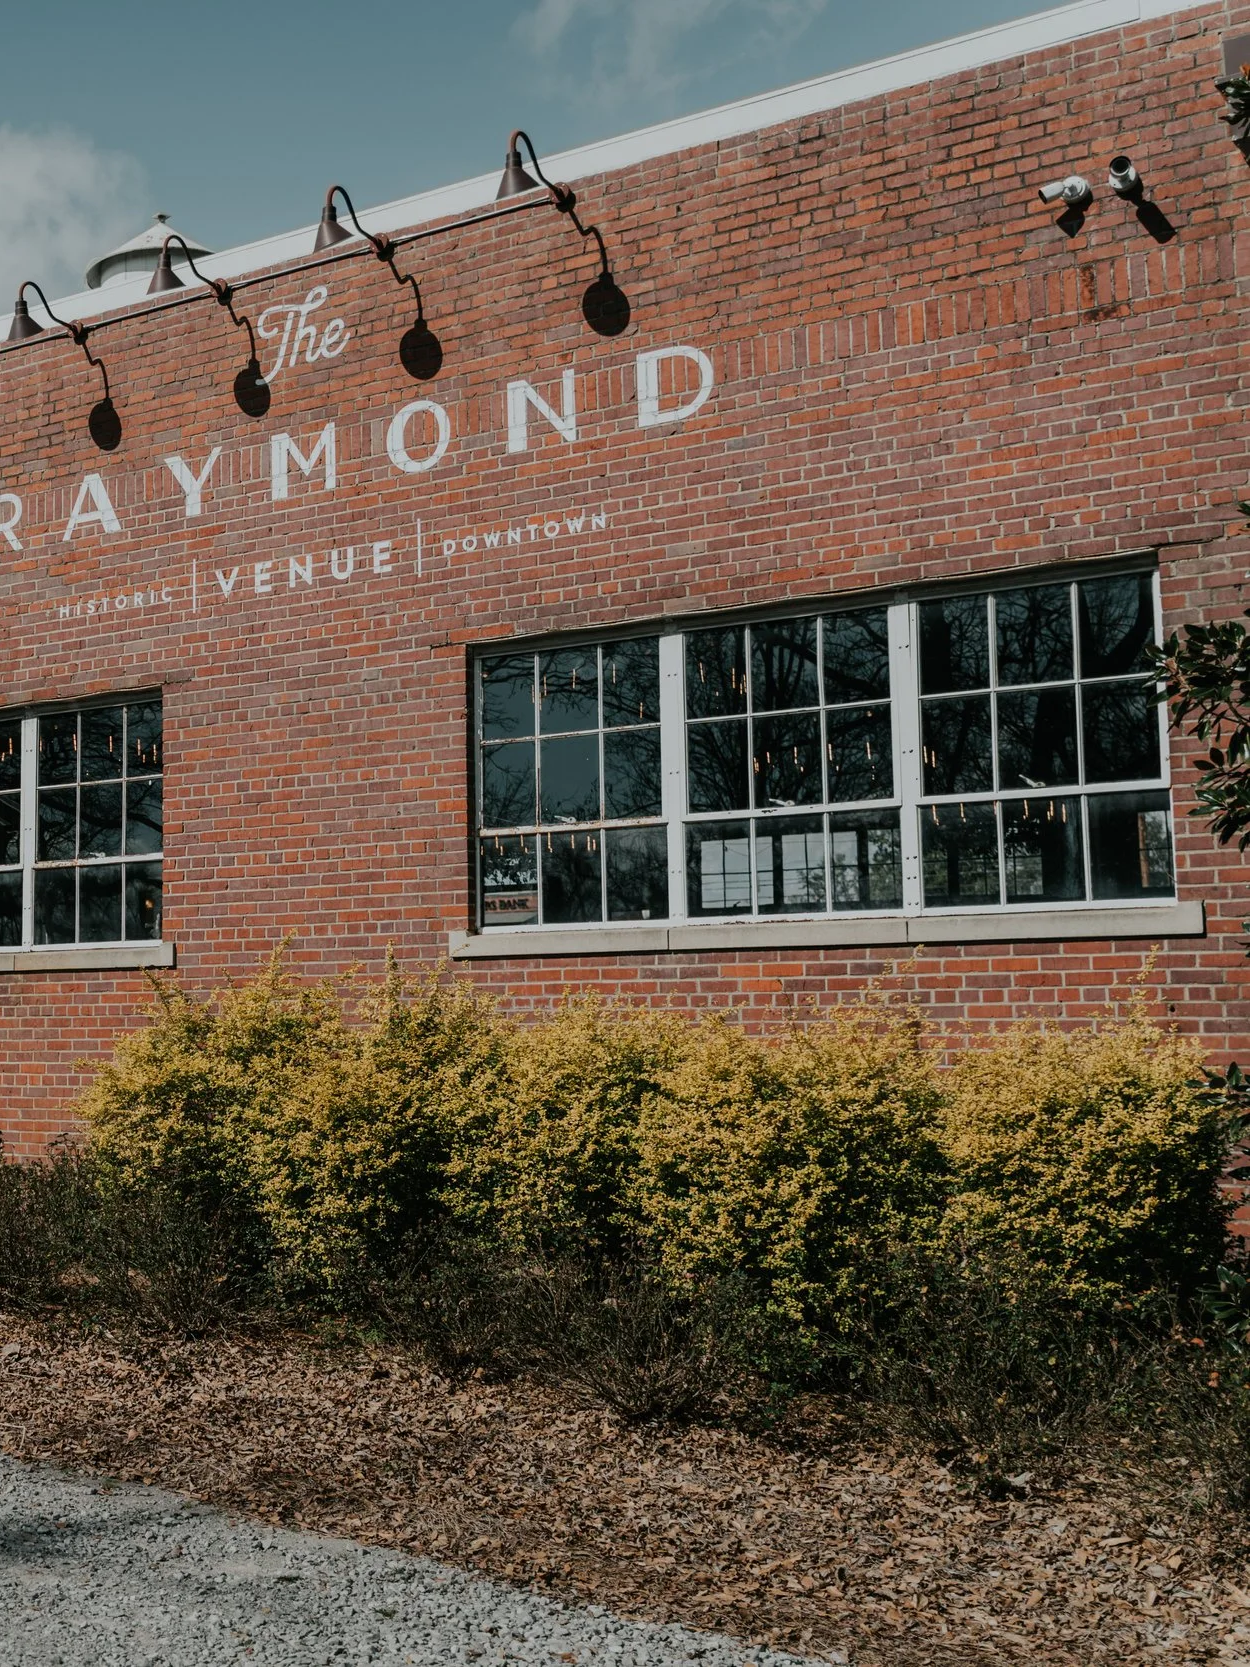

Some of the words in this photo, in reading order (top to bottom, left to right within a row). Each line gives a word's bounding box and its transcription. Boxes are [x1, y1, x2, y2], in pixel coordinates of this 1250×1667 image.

[255, 285, 350, 385] The
[59, 587, 173, 618] HISTORIC
[215, 540, 393, 599] VENUE
[443, 511, 607, 555] DOWNTOWN
